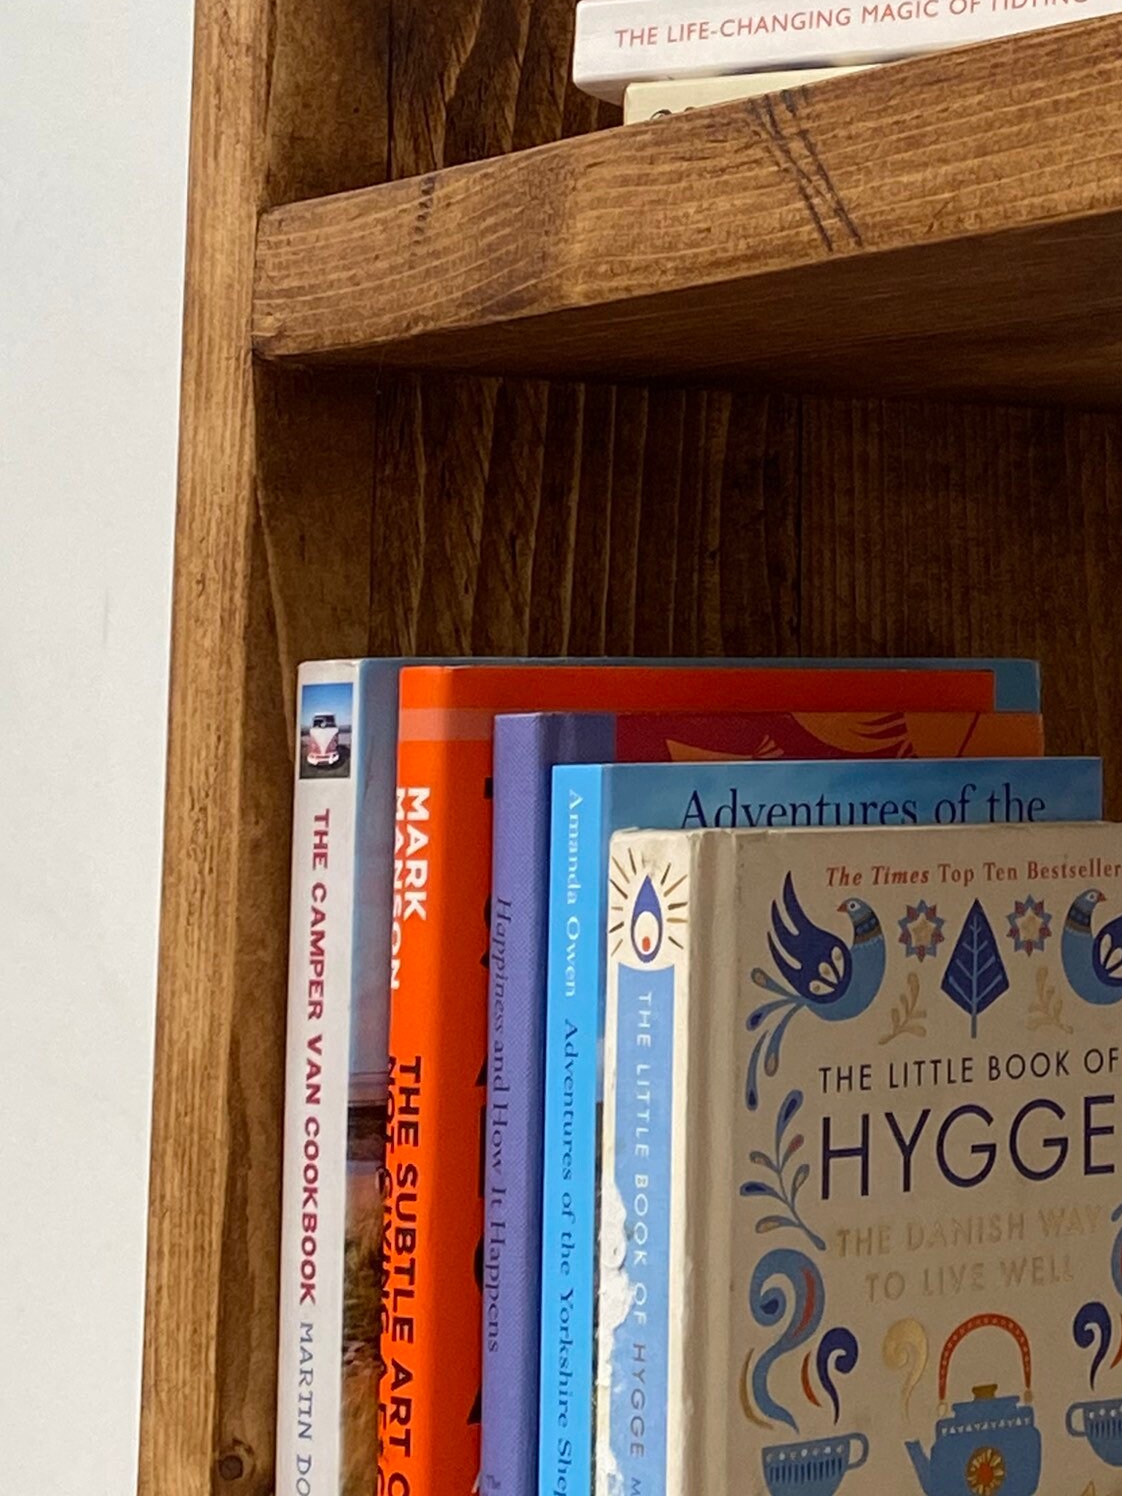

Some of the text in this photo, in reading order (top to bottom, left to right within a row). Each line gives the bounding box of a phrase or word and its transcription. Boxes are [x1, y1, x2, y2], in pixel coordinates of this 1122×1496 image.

[615, 26, 658, 48] THE
[667, 7, 851, 43] LIFE-CHANGING
[403, 787, 431, 921] MARK
[679, 782, 1048, 829] Adventures of the
[565, 789, 584, 997] Amanda Owen
[825, 857, 1122, 888] The Times Top Ten Bestseller
[300, 808, 330, 1305] THE CAMPER VAN COOKBOOK
[397, 1055, 422, 1148] THE
[561, 1018, 579, 1181] Adventures
[818, 1047, 1119, 1094] THE LITTLE BOOK OF
[485, 898, 512, 1354] Happiness and How It Happens
[821, 1093, 1116, 1201] HYGGE
[391, 1163, 419, 1344] SUBTLE
[559, 1231, 575, 1277] the
[561, 1192, 576, 1224] of
[629, 991, 652, 1458] THE LITTLE BOOK OF HYGGE
[836, 1204, 1102, 1259] THE DANISH WAY
[864, 1255, 1074, 1303] TO LIVE WELL
[297, 1322, 314, 1441] MARTIN
[388, 1358, 414, 1458] ART
[557, 1287, 574, 1429] Yorkshire
